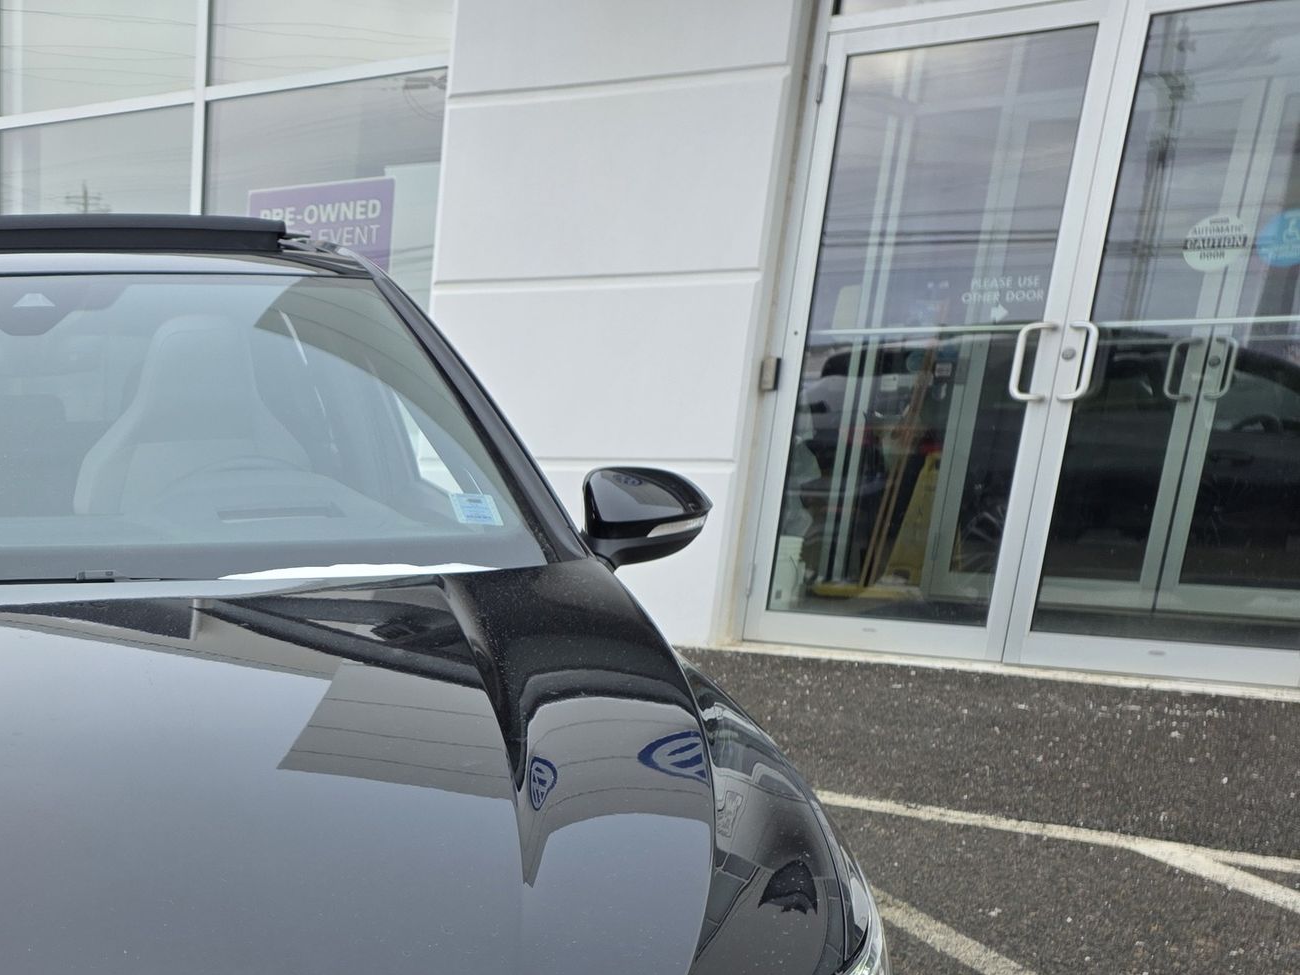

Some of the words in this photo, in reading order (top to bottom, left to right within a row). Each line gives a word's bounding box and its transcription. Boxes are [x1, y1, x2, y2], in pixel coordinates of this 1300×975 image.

[1186, 235, 1245, 249] CAUTION
[971, 276, 1012, 290] PLEASE
[1017, 275, 1040, 287] USE
[961, 290, 1000, 304] OTHER
[1005, 289, 1044, 303] DOOR
